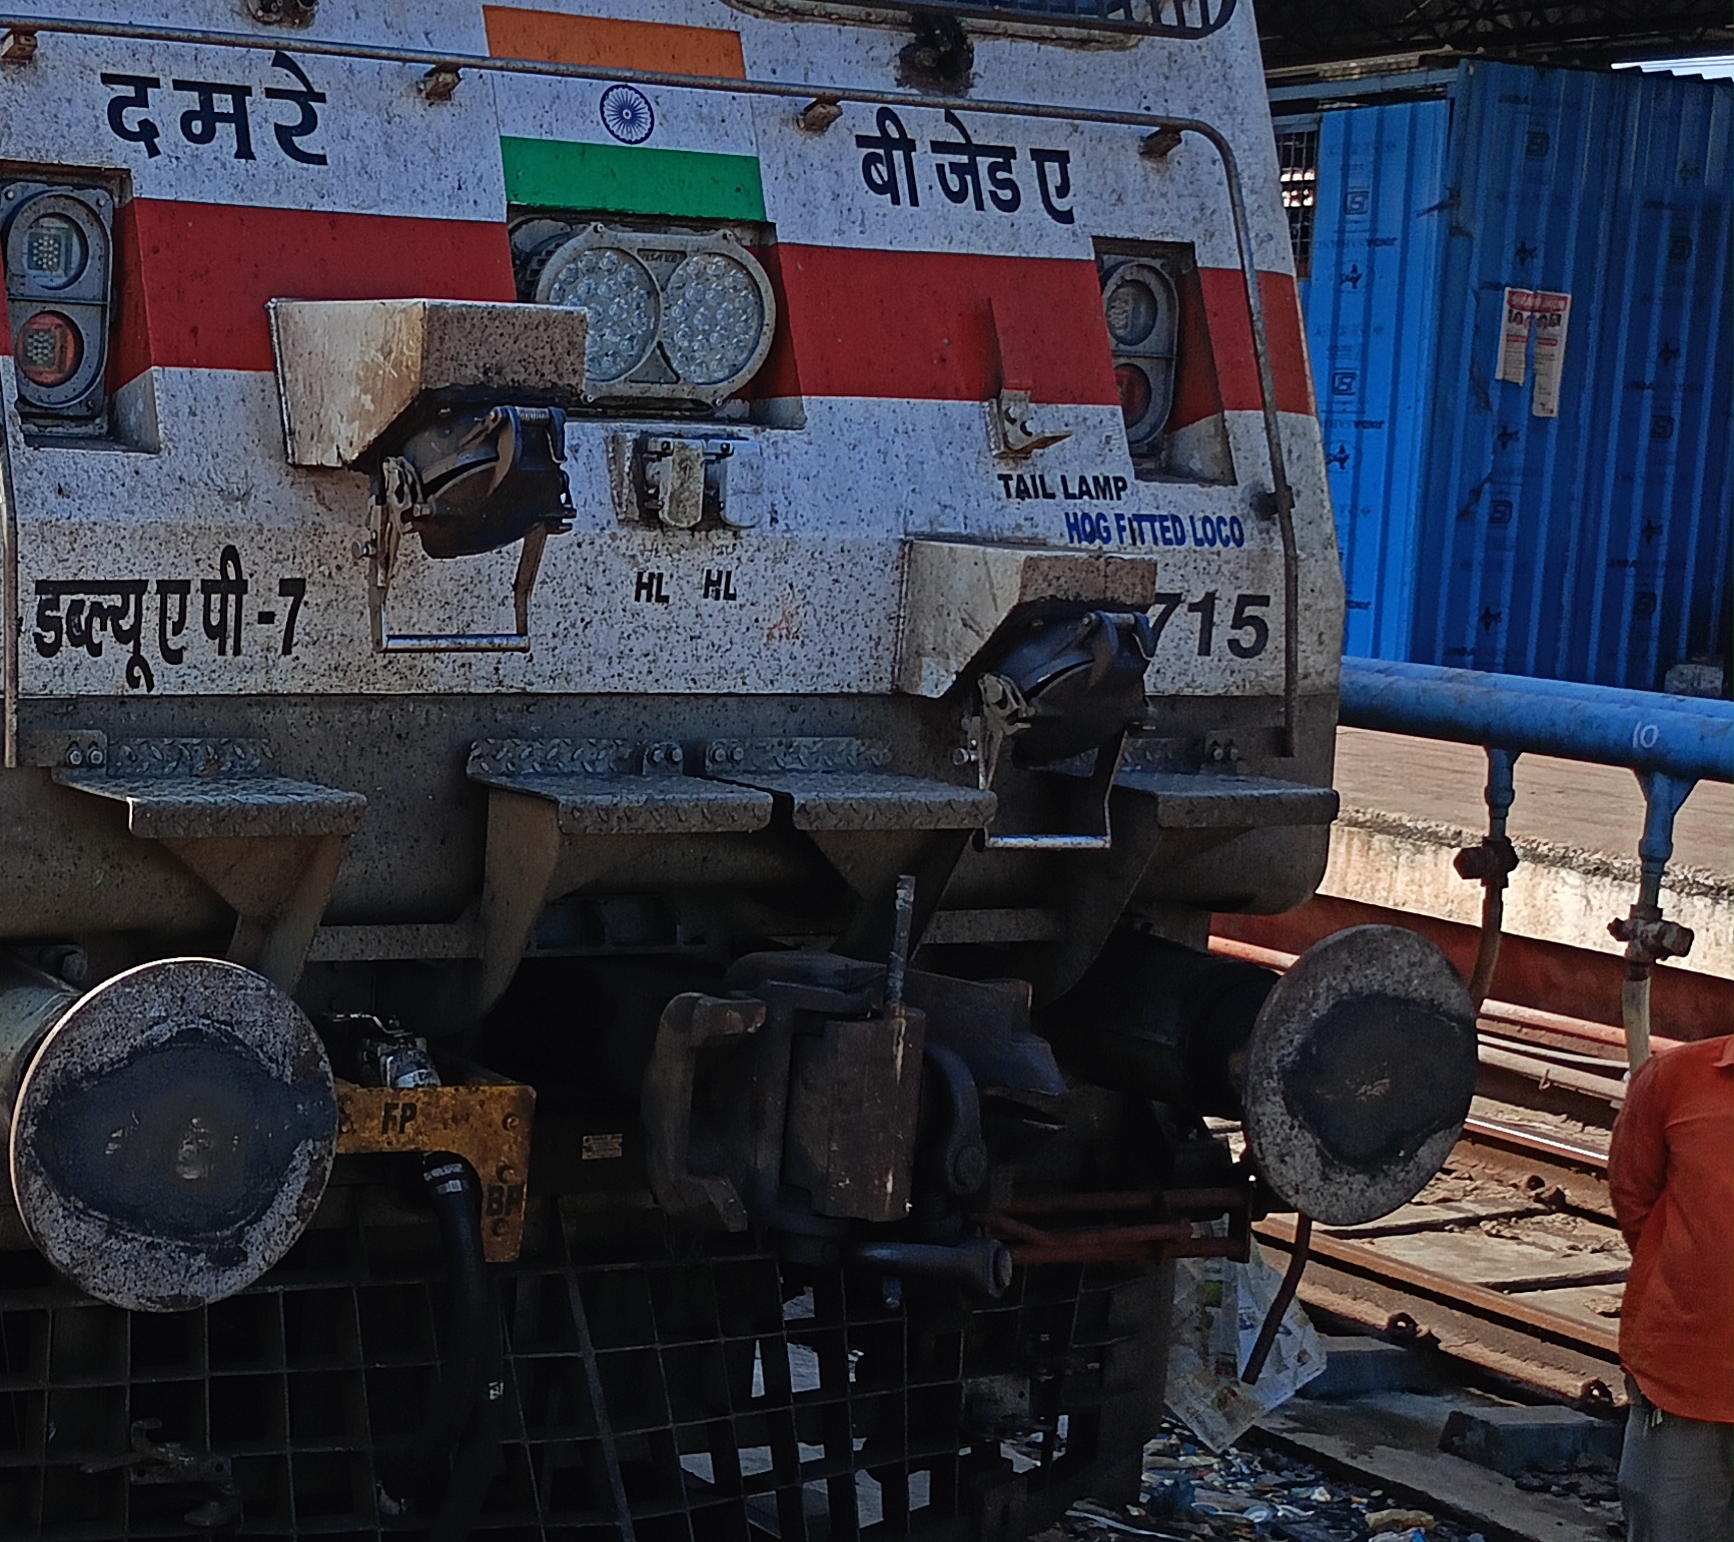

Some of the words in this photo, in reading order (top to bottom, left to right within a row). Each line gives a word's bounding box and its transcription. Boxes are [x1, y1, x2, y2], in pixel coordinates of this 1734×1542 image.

[997, 473, 1056, 500] TAIL
[1061, 474, 1128, 501] LAMP
[1065, 512, 1112, 545] HOG
[1114, 513, 1186, 547] FITTED
[1189, 515, 1245, 548] LOCO
[634, 570, 670, 604] HL
[703, 569, 737, 601] HL
[1632, 721, 1660, 749] 10
[382, 1102, 417, 1135] FP
